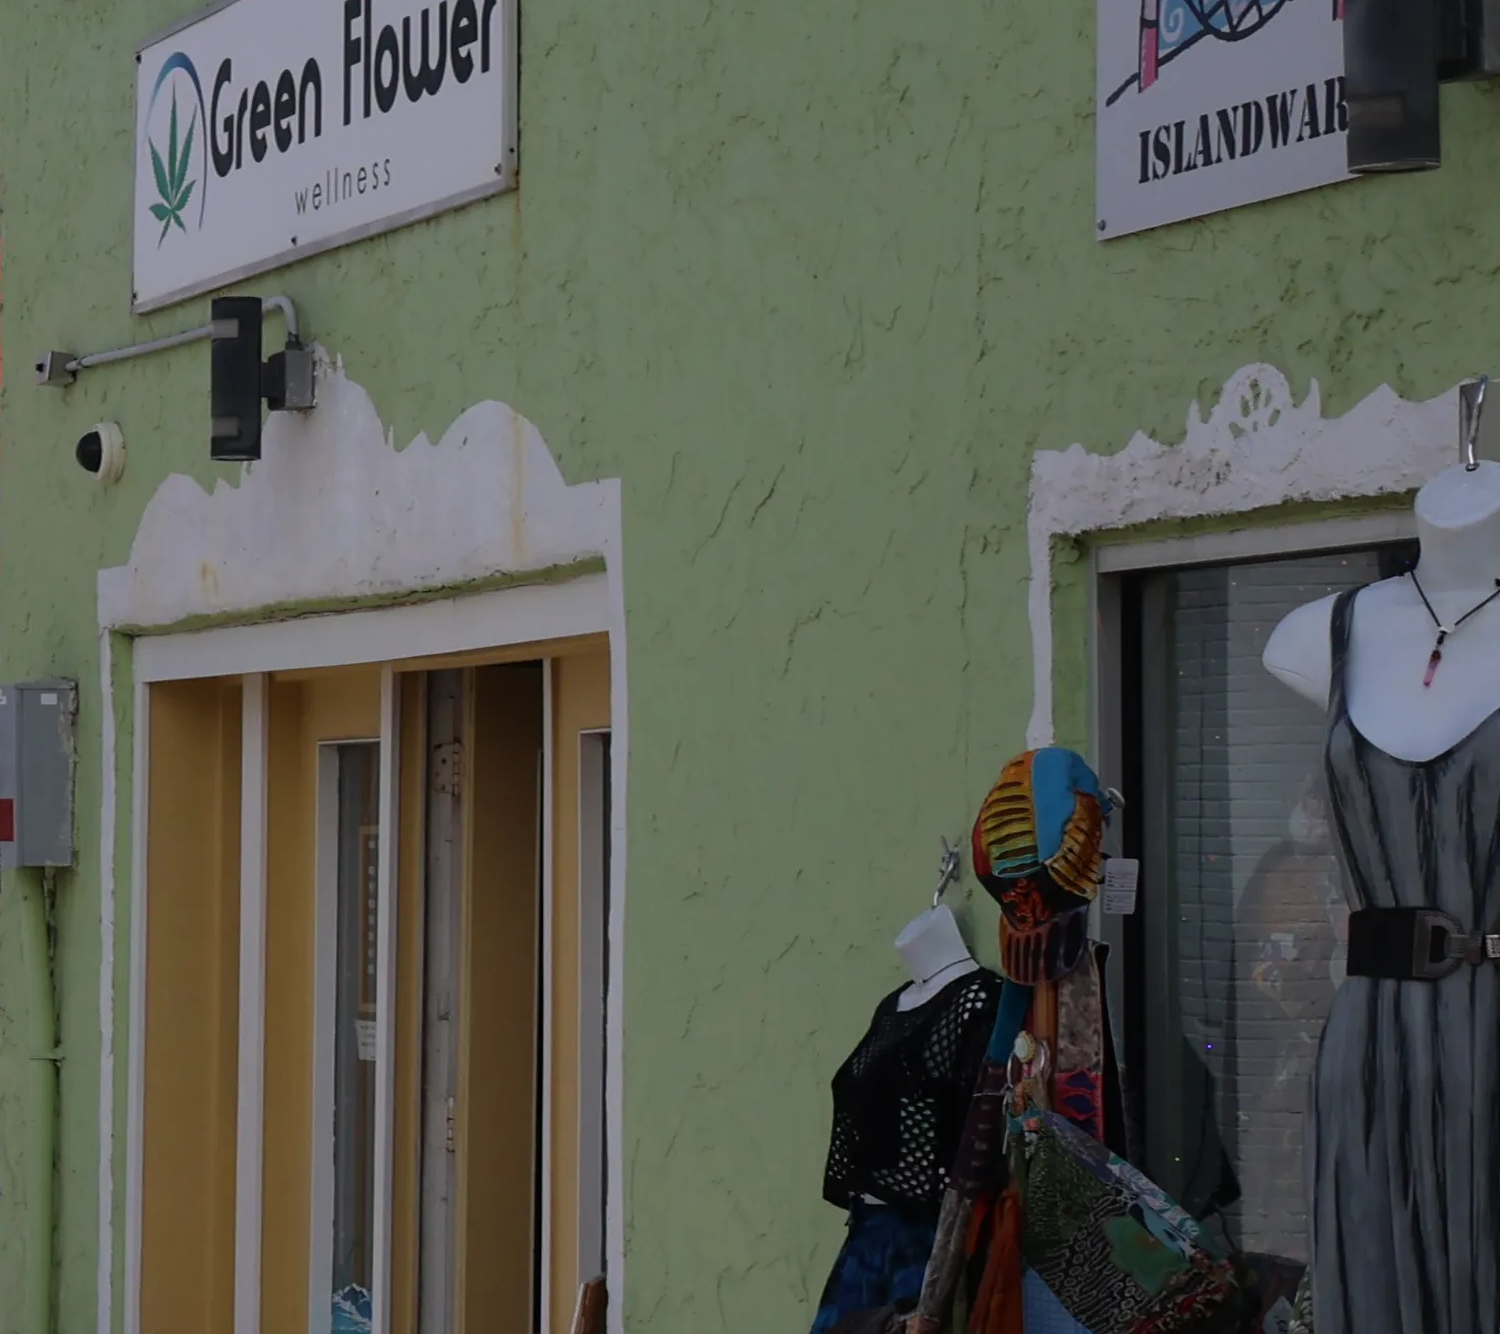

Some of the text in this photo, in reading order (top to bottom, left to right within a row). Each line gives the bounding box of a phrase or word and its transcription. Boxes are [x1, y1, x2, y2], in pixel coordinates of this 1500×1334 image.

[210, 57, 322, 178] Green
[1137, 76, 1349, 184] ISLANDWAR
[295, 157, 392, 216] wellness
